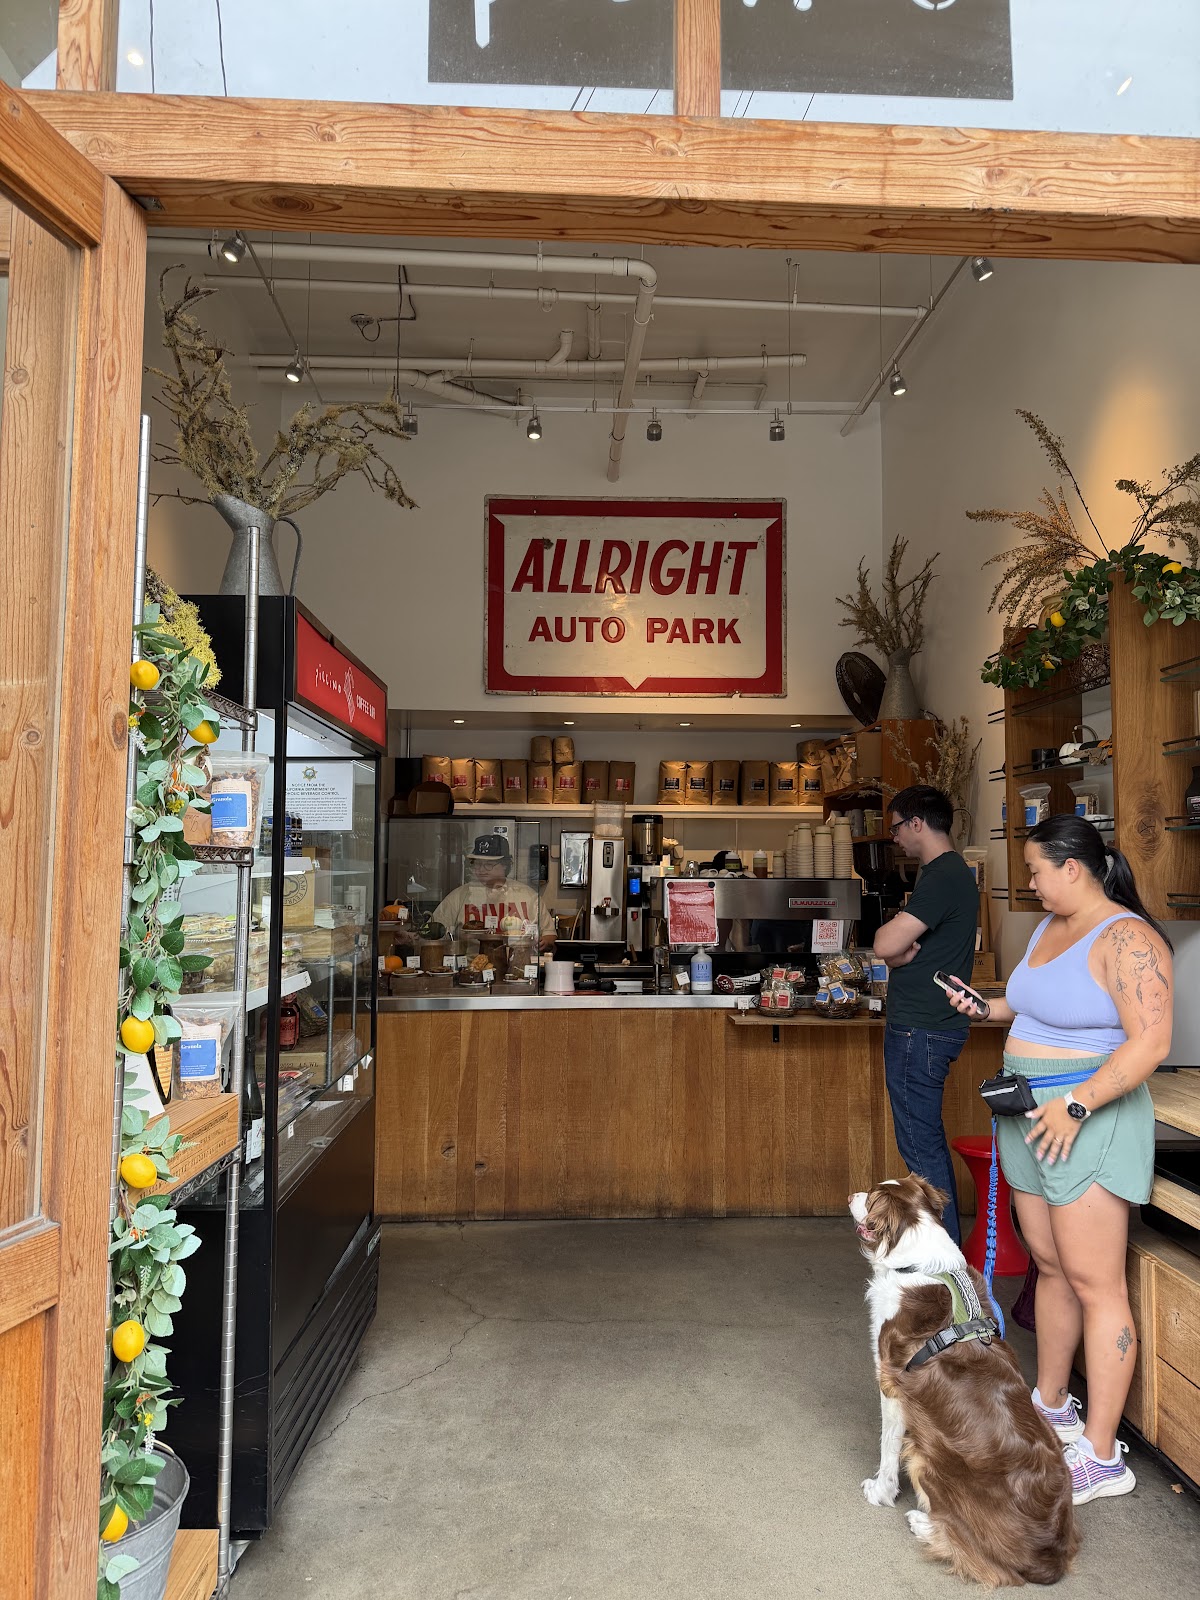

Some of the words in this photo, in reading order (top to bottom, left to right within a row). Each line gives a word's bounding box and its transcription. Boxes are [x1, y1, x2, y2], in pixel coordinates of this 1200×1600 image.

[511, 538, 758, 596] ALLRIGHT
[528, 616, 626, 644] AUTO
[646, 617, 742, 645] PARK
[356, 694, 370, 715] COFFEE
